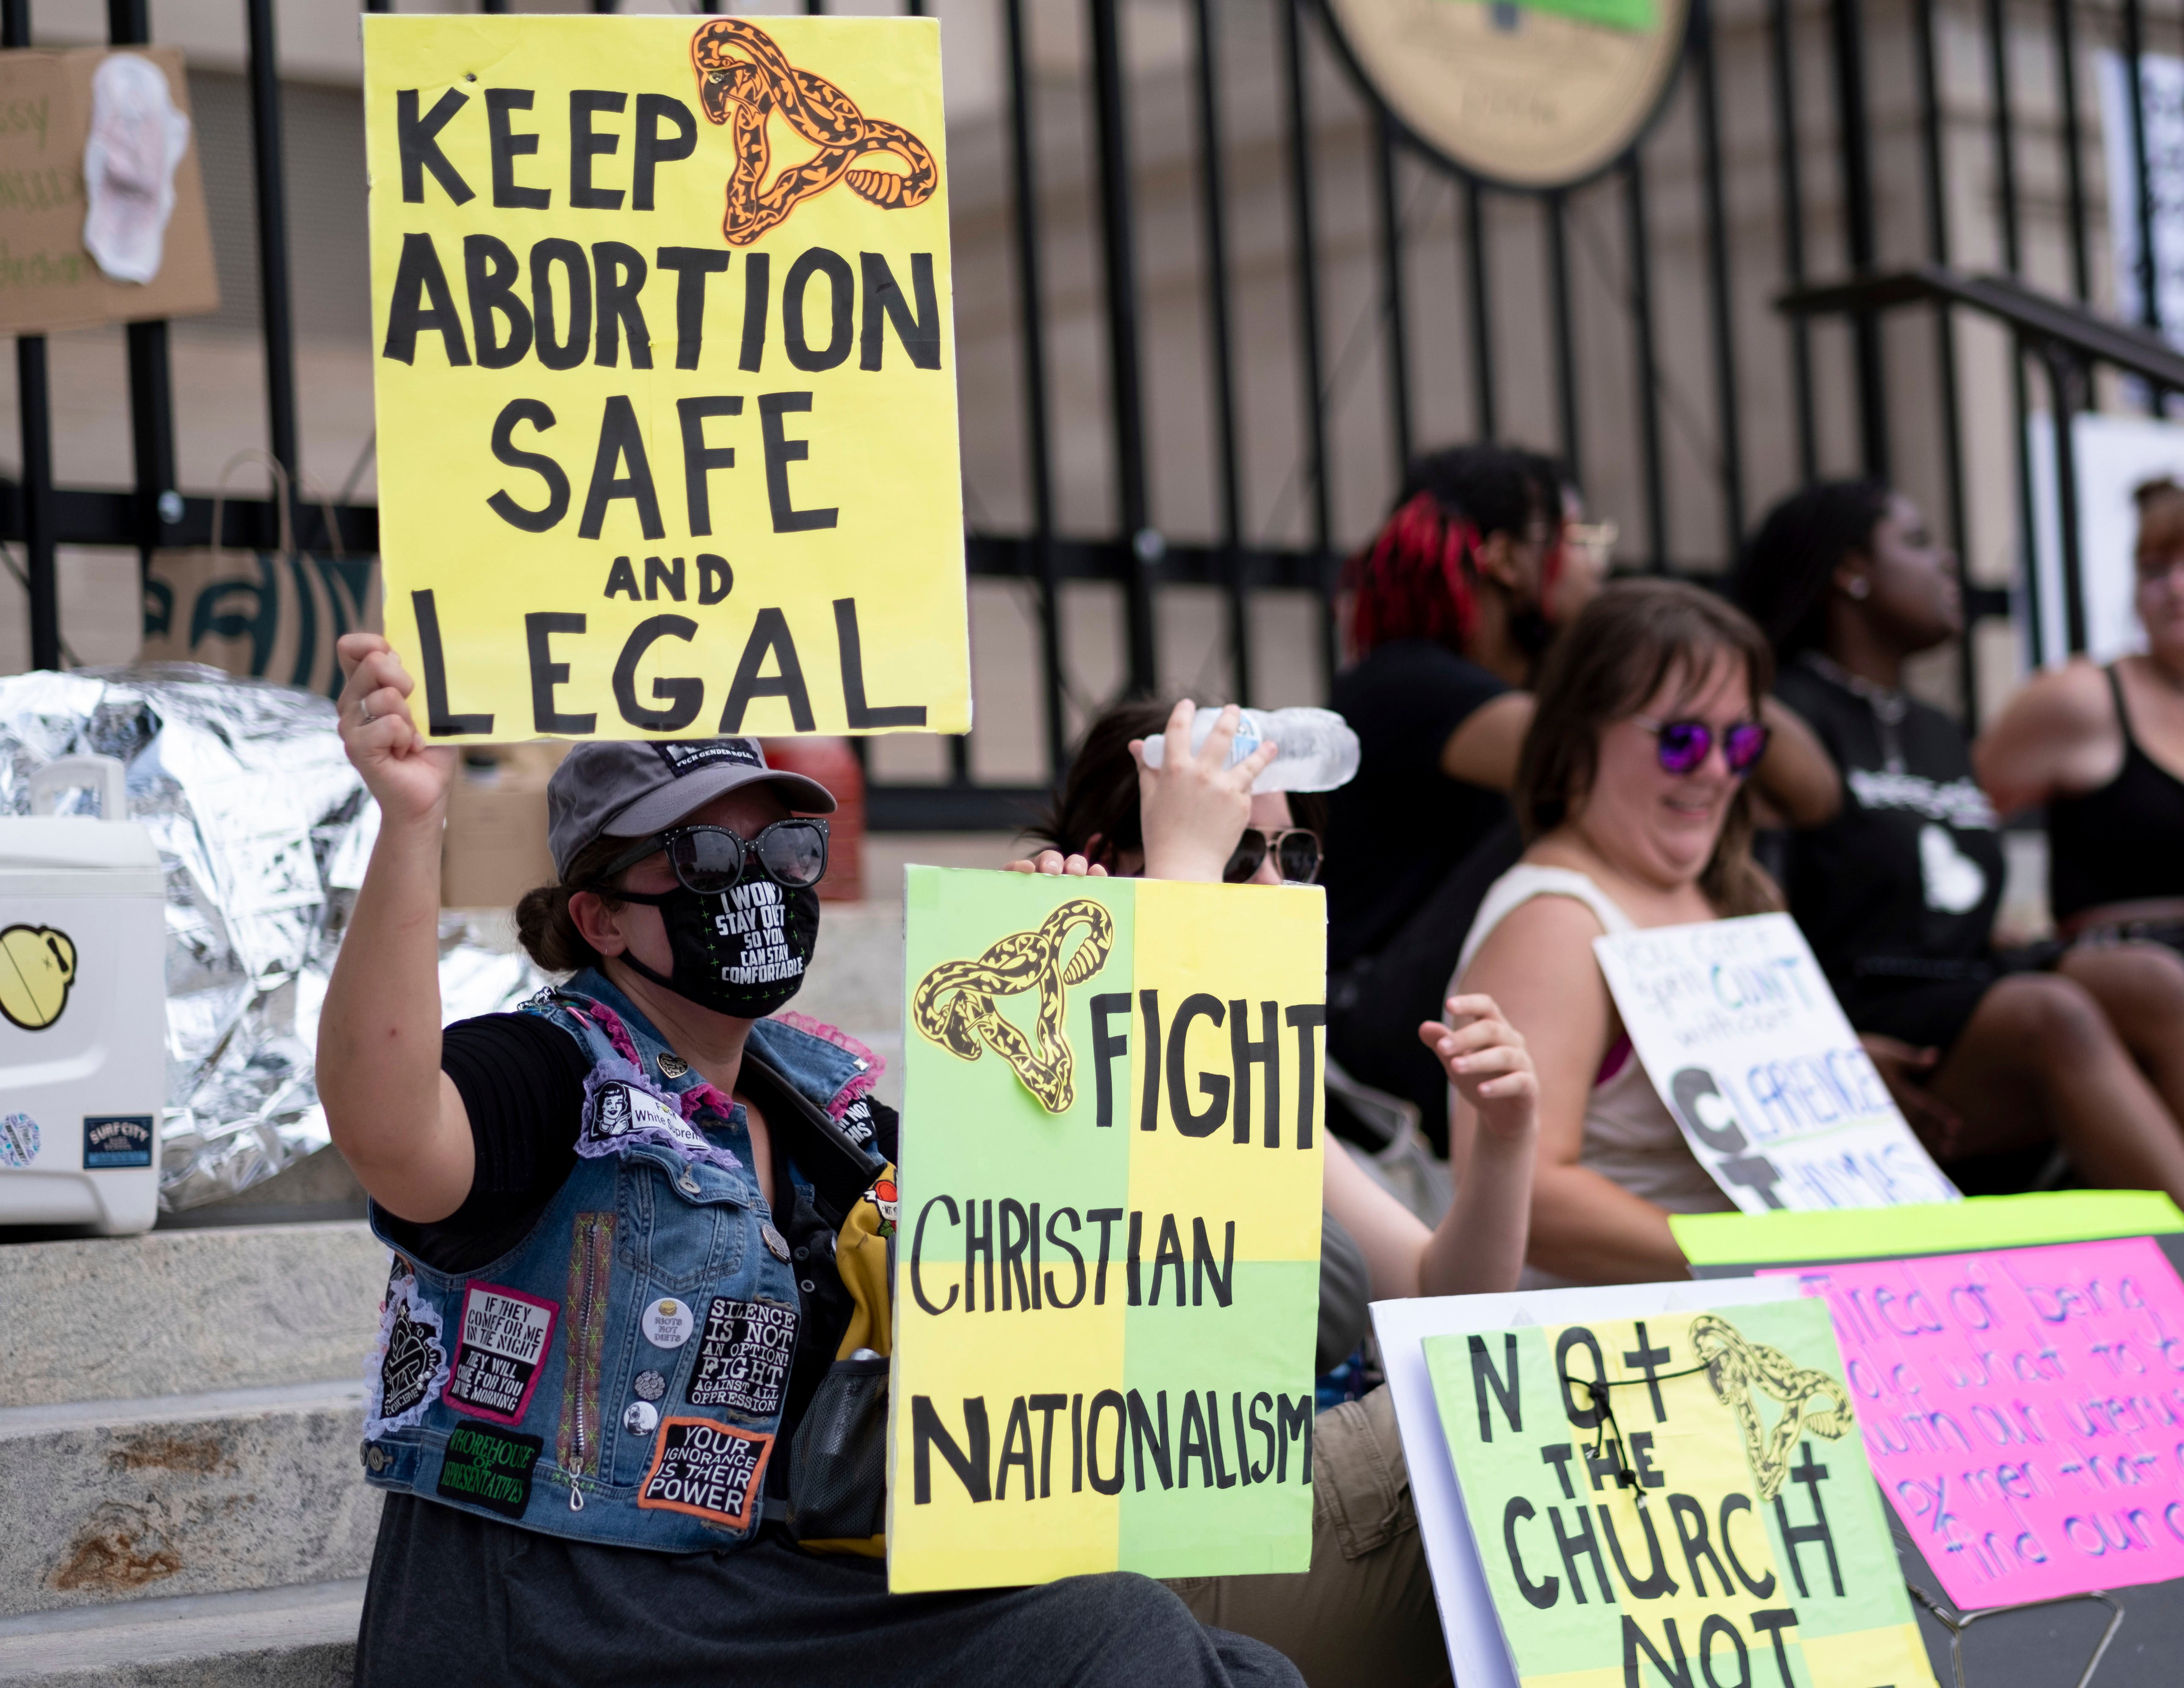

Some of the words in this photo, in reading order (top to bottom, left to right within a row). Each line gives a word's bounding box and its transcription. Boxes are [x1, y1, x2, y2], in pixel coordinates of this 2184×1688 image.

[396, 86, 699, 212] KEEP
[383, 232, 943, 373] ABORTION
[486, 390, 839, 540] SAFE
[603, 553, 734, 606] AND
[411, 588, 928, 738] LEGAL
[677, 755, 699, 767] FUCK
[699, 749, 732, 757] GENDER
[721, 893, 731, 914] I
[715, 907, 756, 936] STAY
[760, 904, 785, 929] QUET
[744, 931, 762, 950] SO
[763, 927, 784, 946] YOU
[740, 948, 766, 967] CAN
[767, 944, 789, 963] STAY
[722, 956, 803, 984] COMFORTABLE
[1089, 989, 1326, 1151] FIGHT
[635, 1110, 666, 1125] White
[655, 1102, 677, 1119] Fck
[845, 1101, 871, 1121] NOT
[89, 1122, 120, 1145] SURF
[121, 1122, 148, 1142] CITY
[844, 1122, 872, 1145] HIS
[911, 1195, 1235, 1316] CHRISTIAN
[485, 1296, 498, 1312] IF
[498, 1300, 532, 1323] THEY
[655, 1317, 682, 1326] RIOTS
[711, 1299, 796, 1330] SILENCE
[468, 1309, 498, 1331] COME
[495, 1316, 523, 1338] FOR
[524, 1325, 544, 1344] ME
[654, 1334, 681, 1342] DIETS
[658, 1326, 678, 1334] NOT
[706, 1318, 734, 1342] IS
[744, 1321, 793, 1352] NOT
[467, 1325, 477, 1342] IN
[496, 1334, 539, 1360] NIGHT
[702, 1342, 725, 1357] AN
[730, 1343, 789, 1367] OPTION!
[491, 1358, 517, 1379] WILL
[698, 1357, 784, 1388] FIGHT
[474, 1370, 499, 1391] FOR
[498, 1377, 524, 1397] YOU
[694, 1379, 750, 1394] AGAINST
[753, 1386, 779, 1399] ALL
[470, 1386, 518, 1411] MORNING
[692, 1391, 777, 1412] OPPRESSION
[449, 1429, 535, 1468] WHOREHOUSE
[684, 1426, 750, 1454] YOUR
[912, 1388, 1312, 1505] NATIONALISM
[473, 1457, 495, 1470] OF
[664, 1447, 757, 1470] IGNORANCE
[1541, 1431, 1665, 1499] THE
[441, 1461, 524, 1504] REPRESENTATIVES
[655, 1462, 678, 1477] IS
[685, 1464, 751, 1490] THEIR
[646, 1478, 744, 1515] POWER
[1504, 1440, 1846, 1609] CHURCH
[2064, 1509, 2154, 1556] our
[1621, 1608, 1799, 1688] NOT
